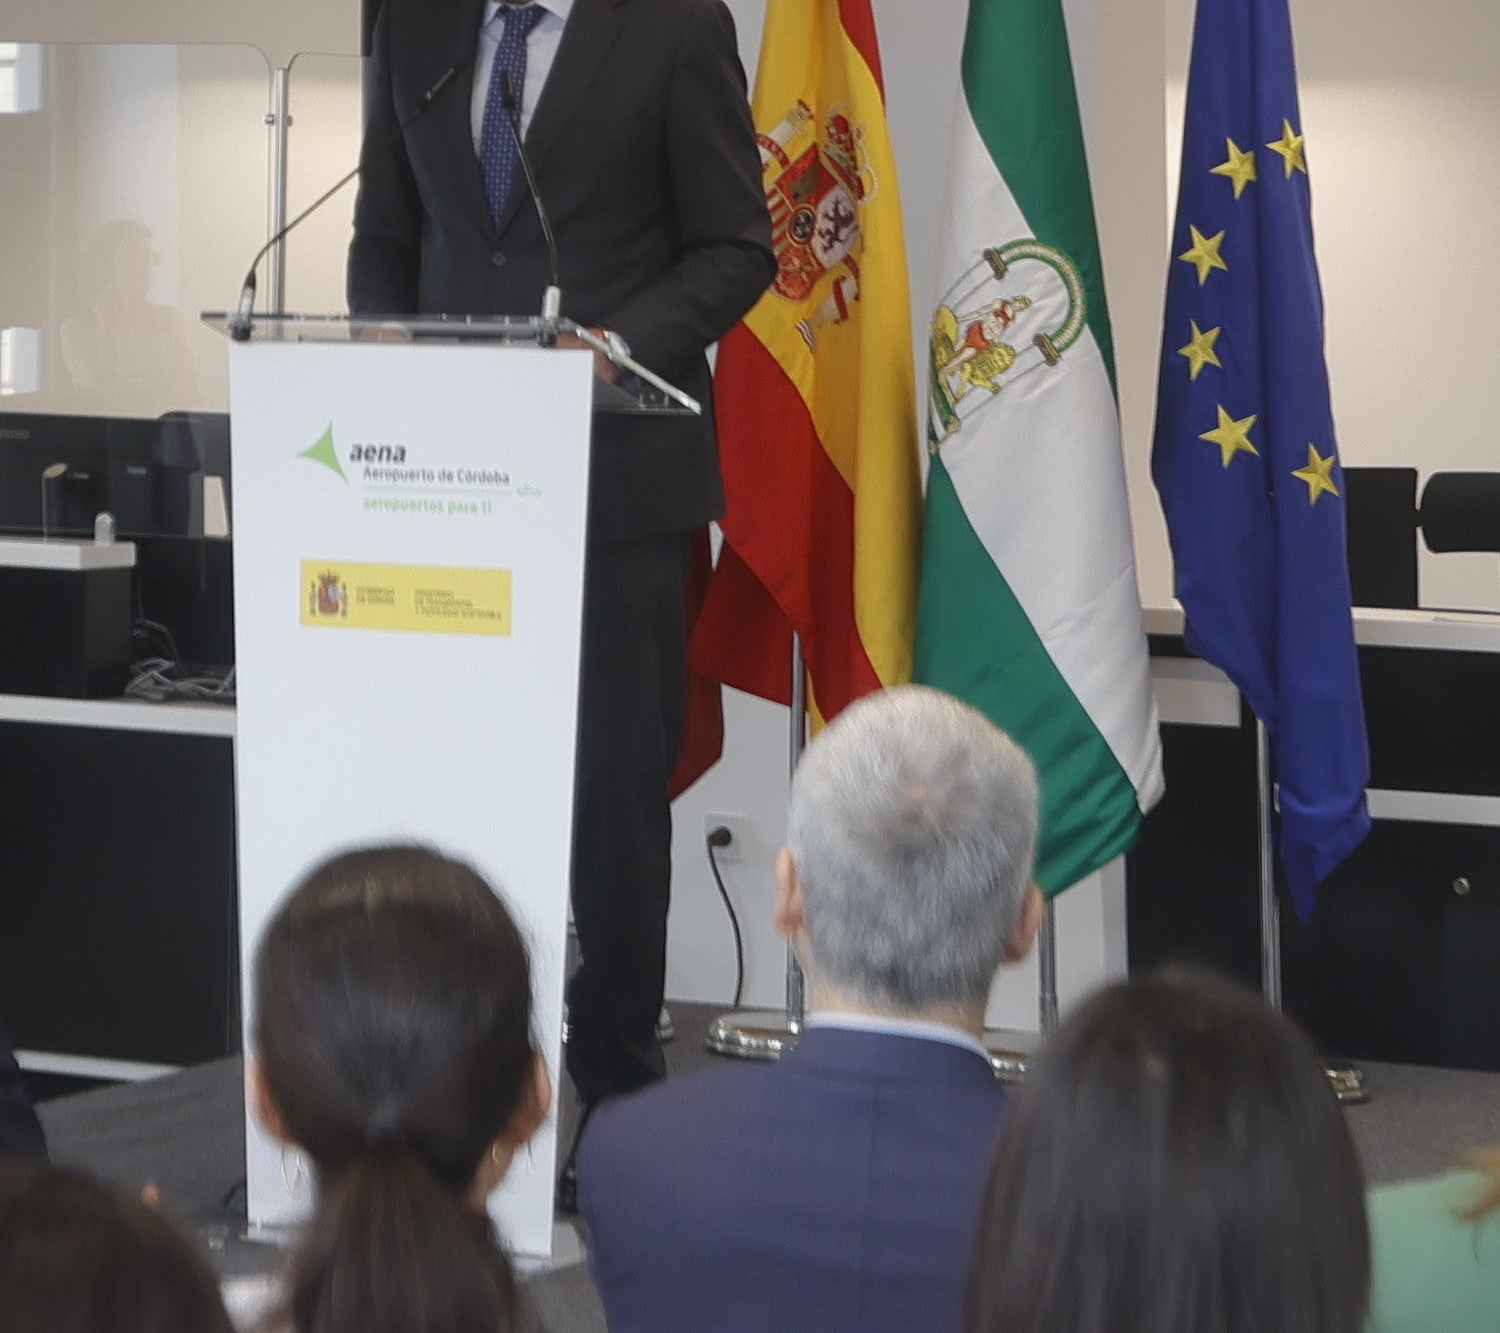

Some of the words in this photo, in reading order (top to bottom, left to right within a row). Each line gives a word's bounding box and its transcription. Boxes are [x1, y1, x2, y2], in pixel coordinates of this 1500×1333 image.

[349, 443, 407, 464] aena
[363, 466, 435, 484] Aeropuerto
[438, 468, 454, 483] de
[457, 468, 510, 486] Córdoba
